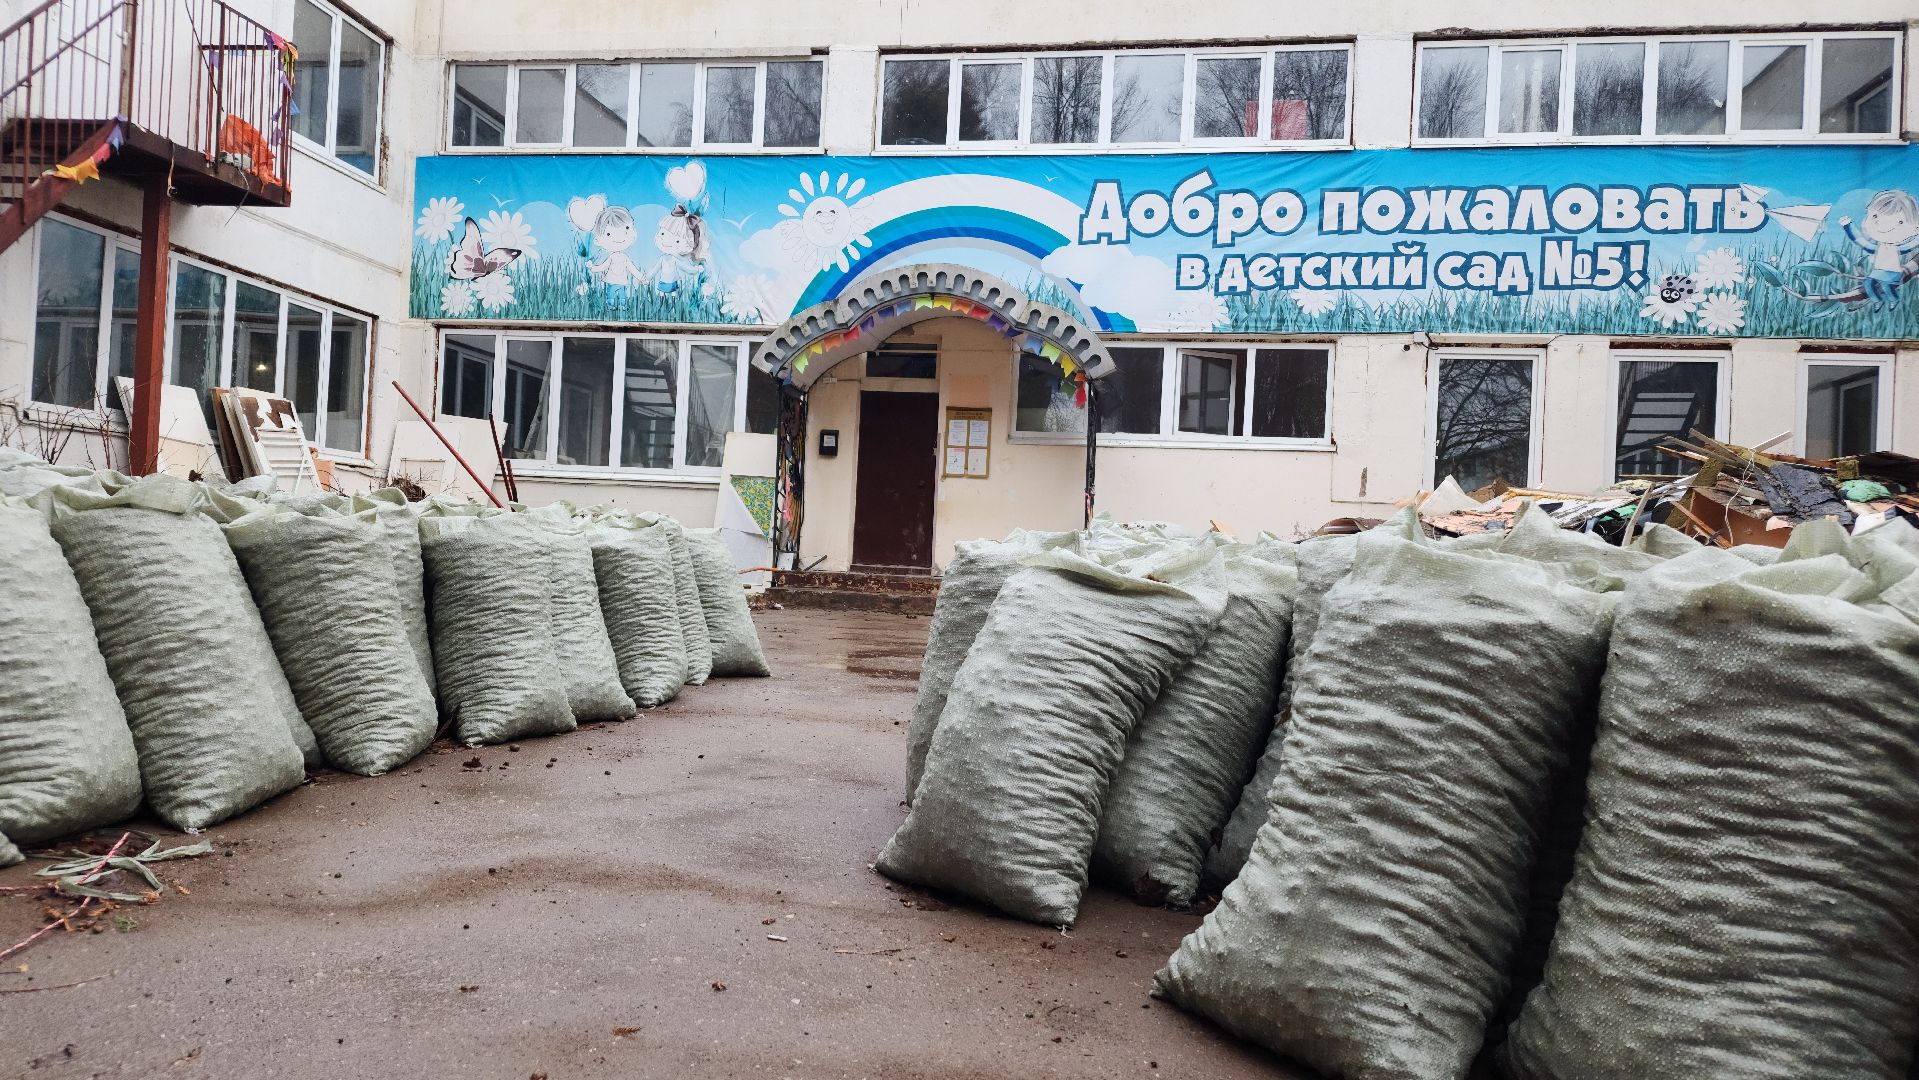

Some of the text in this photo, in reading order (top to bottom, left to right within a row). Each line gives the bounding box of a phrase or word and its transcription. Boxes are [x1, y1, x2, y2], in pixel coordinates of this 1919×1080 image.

[1079, 169, 1767, 246] Добро пожаловать
[1176, 237, 1650, 295] в детский сад №5!
